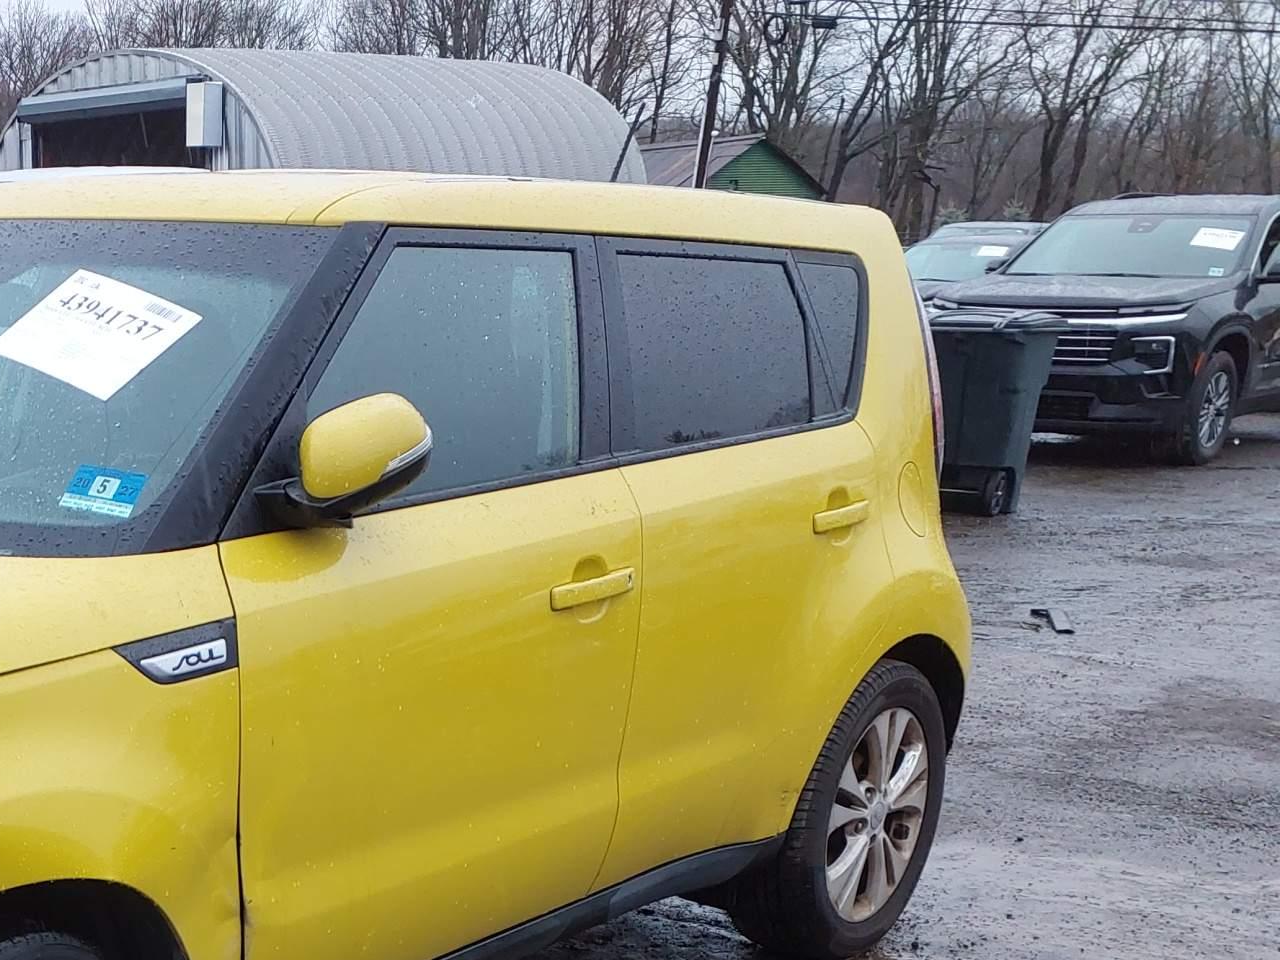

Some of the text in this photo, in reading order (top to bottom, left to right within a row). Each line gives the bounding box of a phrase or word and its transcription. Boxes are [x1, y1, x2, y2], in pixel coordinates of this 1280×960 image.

[59, 293, 165, 341] 43941737
[72, 477, 138, 497] 20 5 27
[172, 647, 225, 671] SOUL
